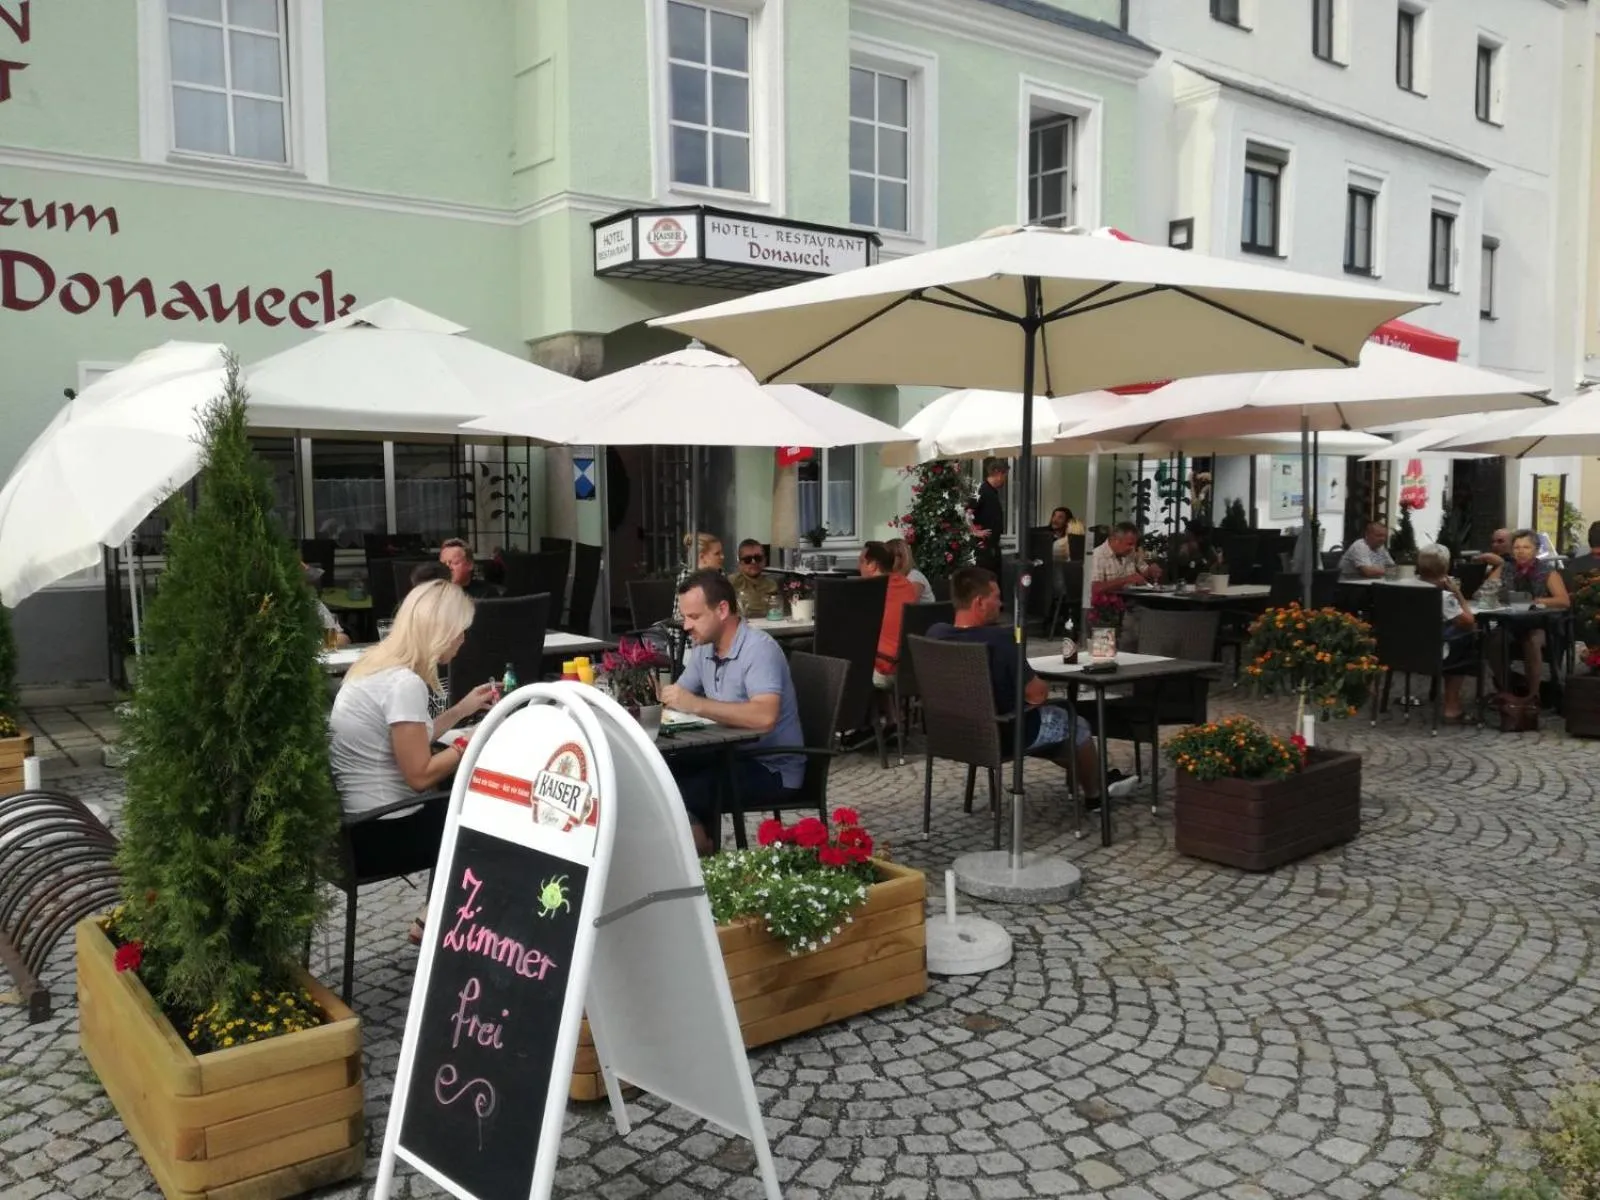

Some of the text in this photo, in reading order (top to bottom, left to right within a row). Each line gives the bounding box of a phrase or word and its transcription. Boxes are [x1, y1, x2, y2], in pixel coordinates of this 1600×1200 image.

[0, 195, 119, 235] zum
[711, 221, 758, 239] HOTEL
[603, 230, 625, 247] HOTEL
[653, 231, 682, 242] KAISER
[747, 241, 831, 267] Donaueck
[0, 249, 356, 329] Donaueck
[538, 772, 582, 812] KAISER
[442, 867, 559, 982] Zimmer
[450, 976, 511, 1050] frei
